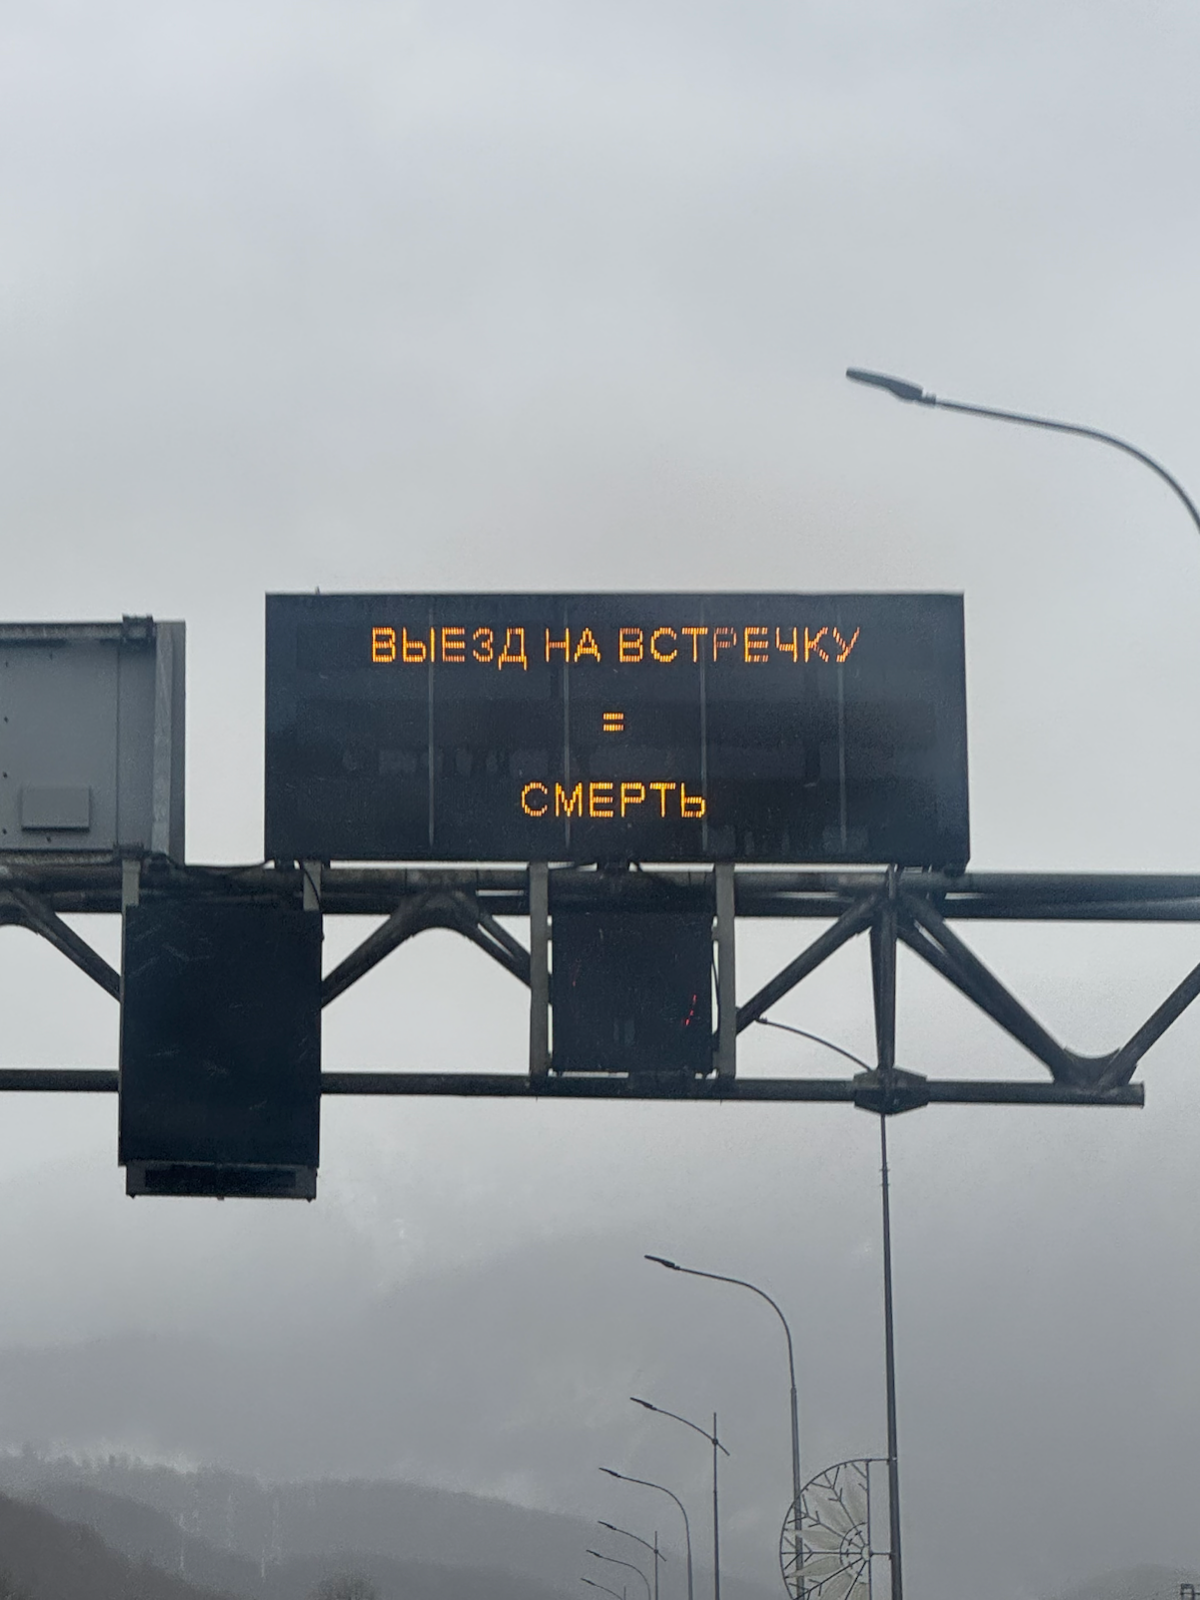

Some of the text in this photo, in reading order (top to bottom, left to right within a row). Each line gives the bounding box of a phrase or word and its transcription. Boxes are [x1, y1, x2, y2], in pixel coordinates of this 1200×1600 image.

[370, 625, 861, 670] ВЫЕЗД НА ВСТРЕЧКУ
[602, 711, 625, 732] =
[520, 780, 707, 819] СМЕРТЬ
